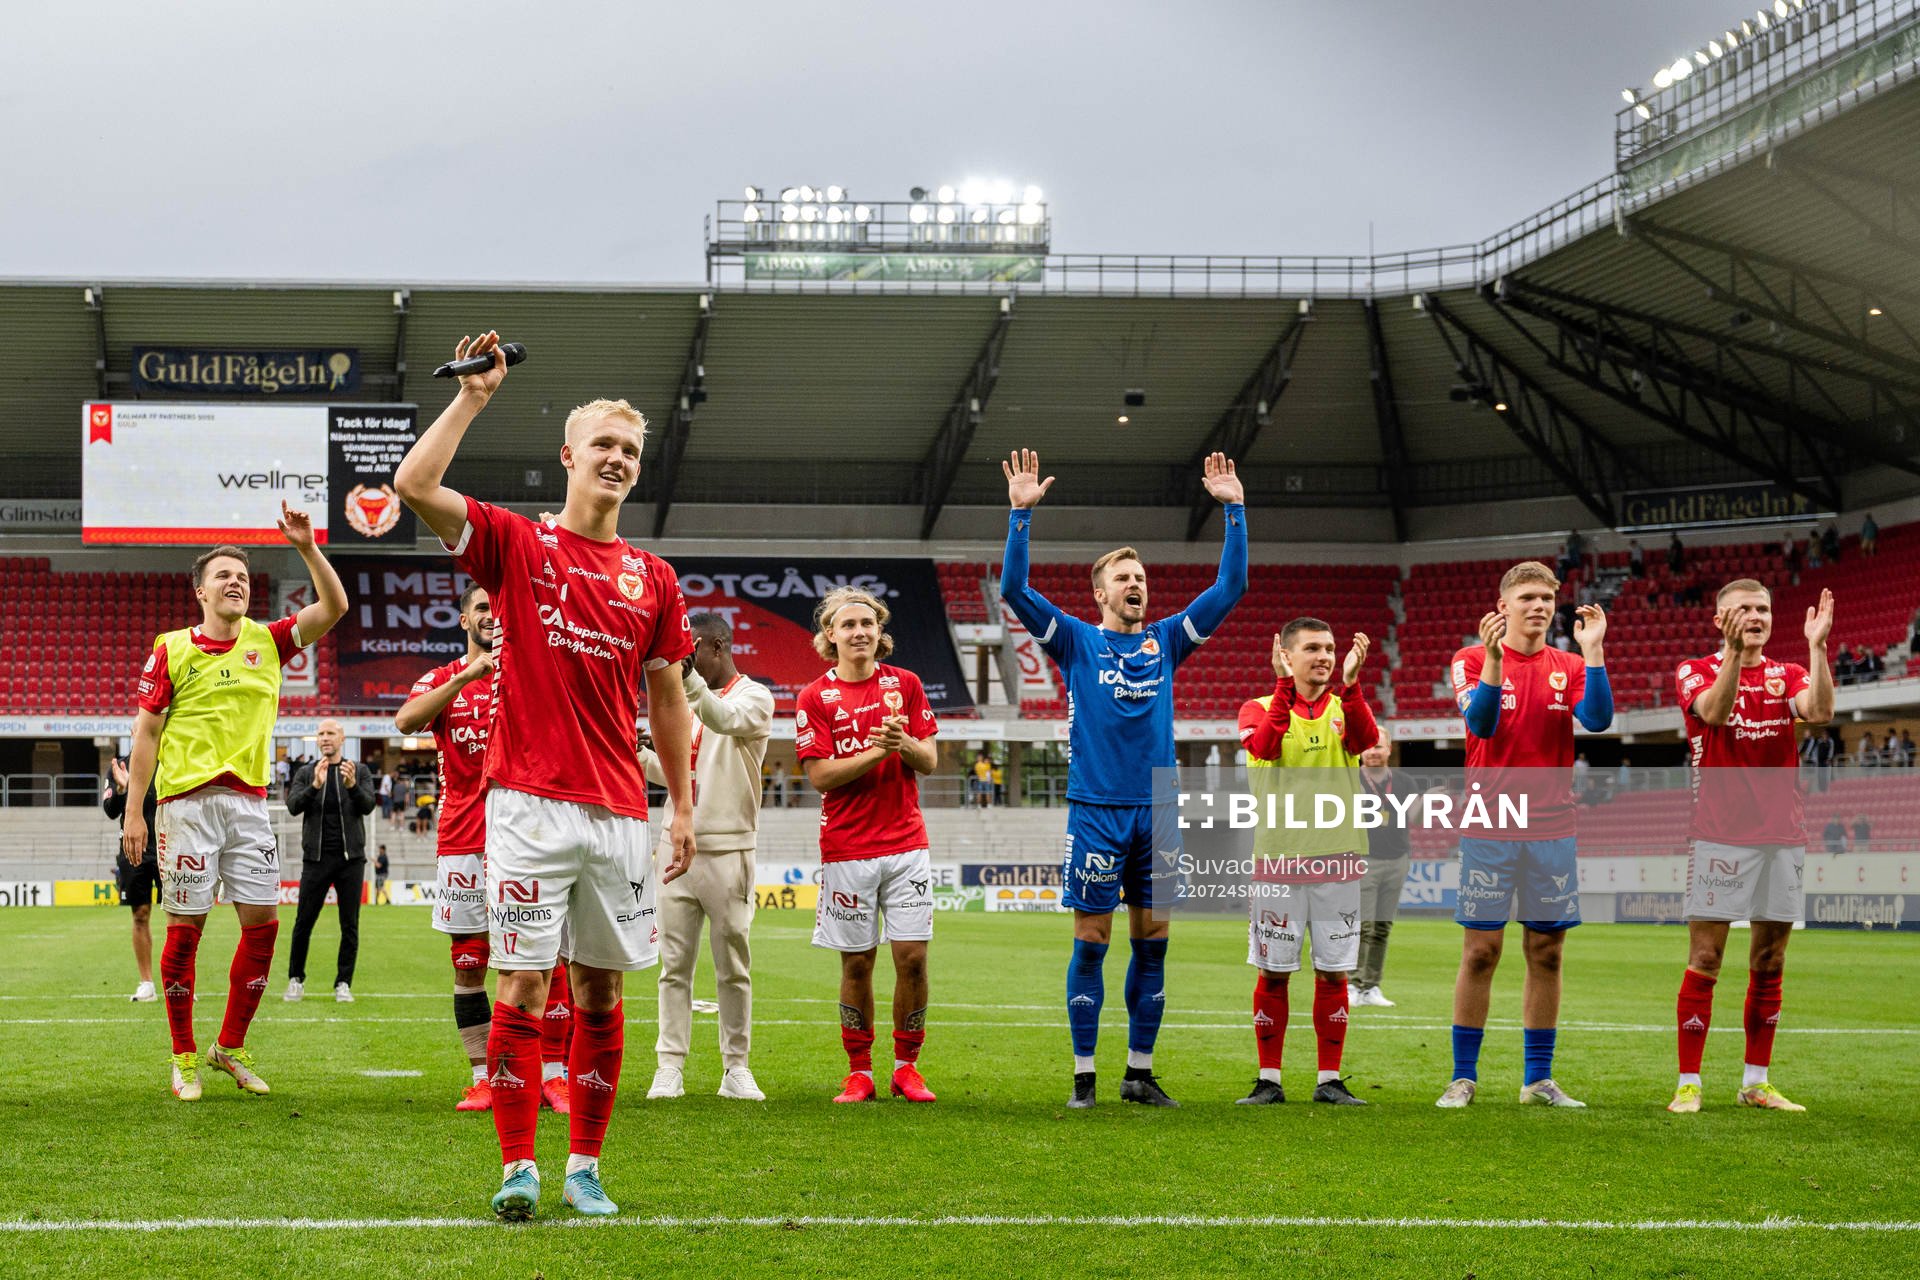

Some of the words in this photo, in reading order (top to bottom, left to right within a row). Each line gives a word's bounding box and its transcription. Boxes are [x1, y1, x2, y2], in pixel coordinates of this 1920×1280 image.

[139, 351, 328, 393] GuldFågeln
[336, 417, 363, 428] Tack
[365, 417, 381, 428] för
[218, 470, 328, 489] wellne
[567, 566, 611, 582] SPORTWAY
[680, 567, 899, 598] OTGÅNG.
[537, 602, 565, 629] CA
[566, 620, 635, 651] Supermarket
[361, 639, 465, 653] Kärleken
[548, 631, 615, 660] Borgholm
[1098, 669, 1127, 685] ICA
[1501, 693, 1517, 710] 30
[451, 726, 477, 743] ICA
[835, 736, 864, 754] ICA
[1075, 867, 1119, 885] Nybloms
[1698, 874, 1745, 889] Nybloms
[439, 888, 484, 904] Nybloms
[1462, 886, 1505, 900] Nybloms
[1707, 891, 1714, 906] 3
[441, 905, 451, 922] 14
[491, 906, 552, 928] Nybloms
[1463, 902, 1477, 918] 32
[504, 932, 518, 955] 17
